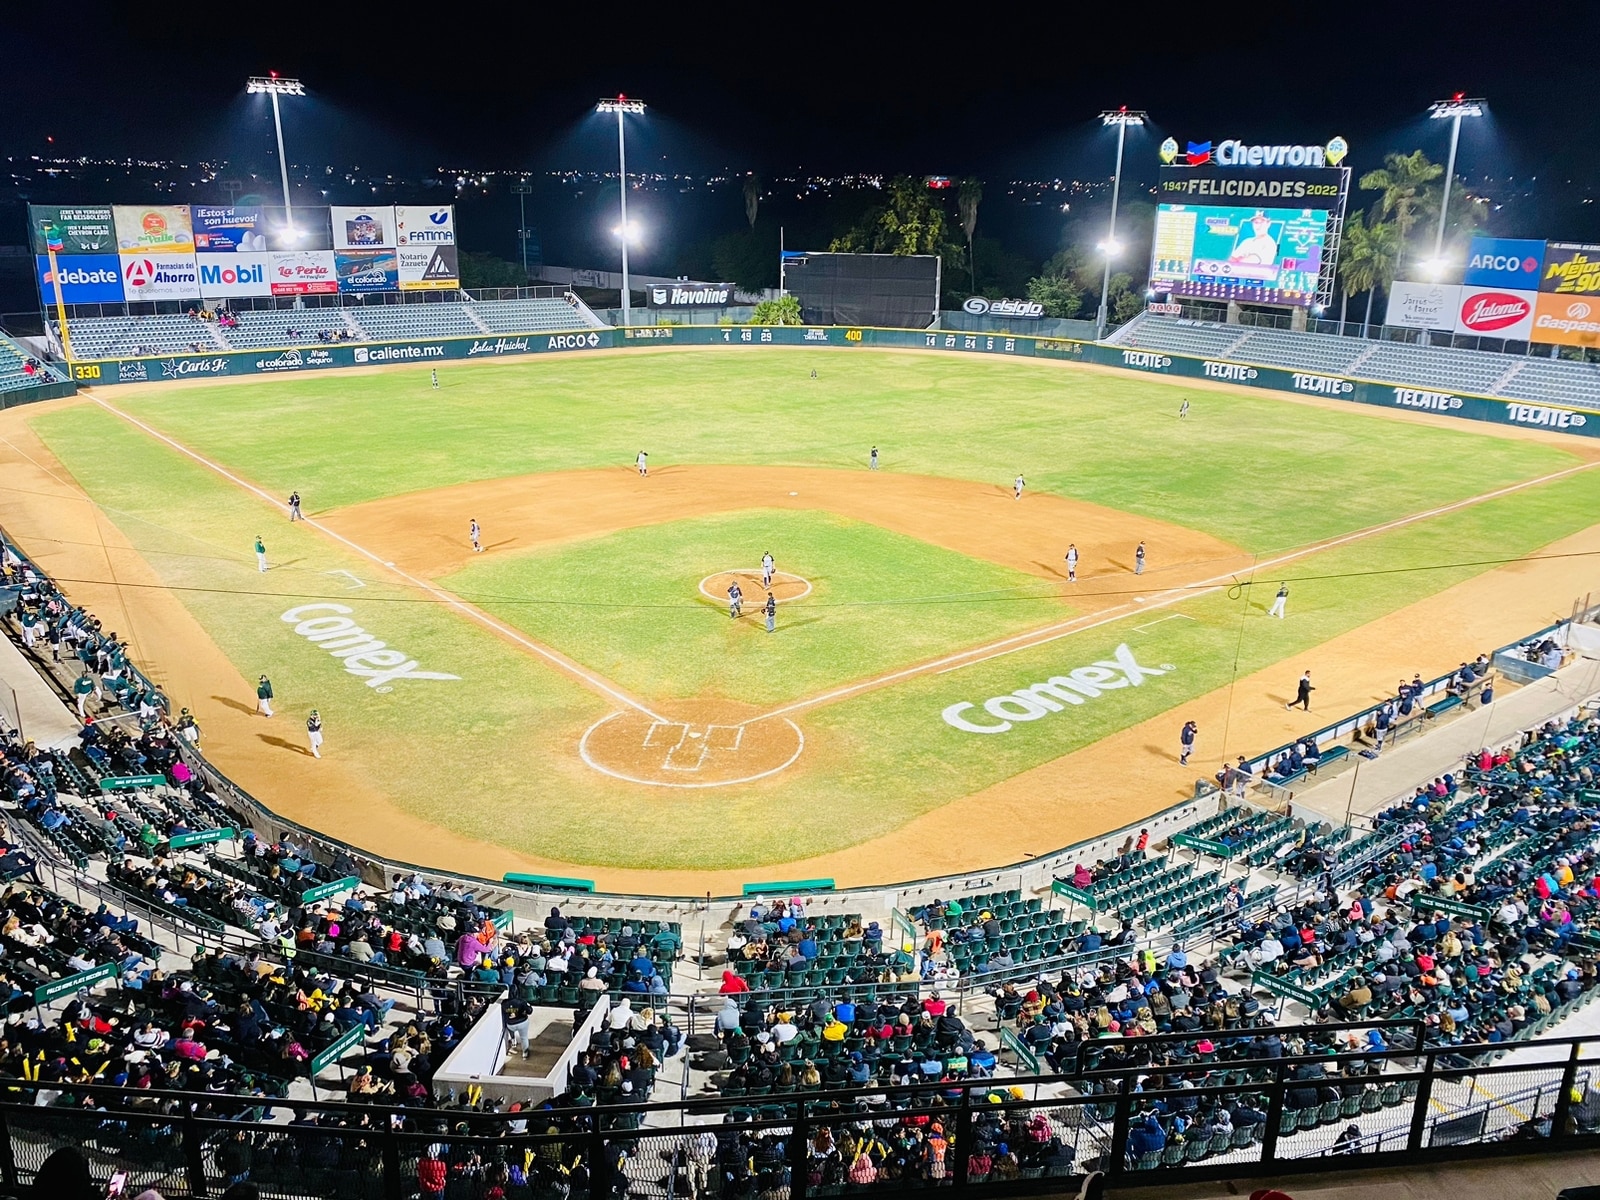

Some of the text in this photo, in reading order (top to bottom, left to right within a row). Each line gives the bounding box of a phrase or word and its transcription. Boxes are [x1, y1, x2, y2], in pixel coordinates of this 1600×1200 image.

[1216, 139, 1323, 166] Chevron
[1162, 179, 1338, 198] 1947 FELICIDADES 2022
[197, 208, 226, 218] ¡Estos
[222, 213, 258, 225] huevos!
[156, 262, 184, 270] Farmacias
[1469, 253, 1520, 272] ARCO
[1572, 252, 1588, 265] la
[57, 267, 118, 285] debate
[154, 271, 196, 283] Ahorro
[200, 264, 263, 285] Mobil
[278, 265, 329, 278] La Perla
[347, 275, 388, 284] el colorado
[671, 288, 729, 304] Havoline
[1467, 298, 1527, 325] Jaloma
[1536, 314, 1600, 334] Gaspas
[548, 334, 586, 349] ARCO
[723, 332, 729, 341] 4
[740, 332, 752, 341] 49
[760, 332, 772, 341] 29
[845, 330, 862, 341] 400
[926, 336, 935, 346] 14
[945, 337, 956, 347] 27
[468, 340, 494, 355] Salsa
[965, 339, 976, 348] 24
[1005, 341, 1015, 351] 21
[369, 345, 444, 361] caliente.mx
[1122, 350, 1164, 369] TECATE
[178, 358, 228, 374] Carl's Jr.
[256, 357, 303, 368] el colorado
[75, 365, 101, 379] 330
[1202, 361, 1249, 380] TECATE
[1291, 373, 1343, 394] TECATE
[1393, 387, 1451, 409] TECATE
[1506, 403, 1574, 427] TECATE
[280, 603, 462, 688] Comex
[942, 642, 1167, 734] Comex
